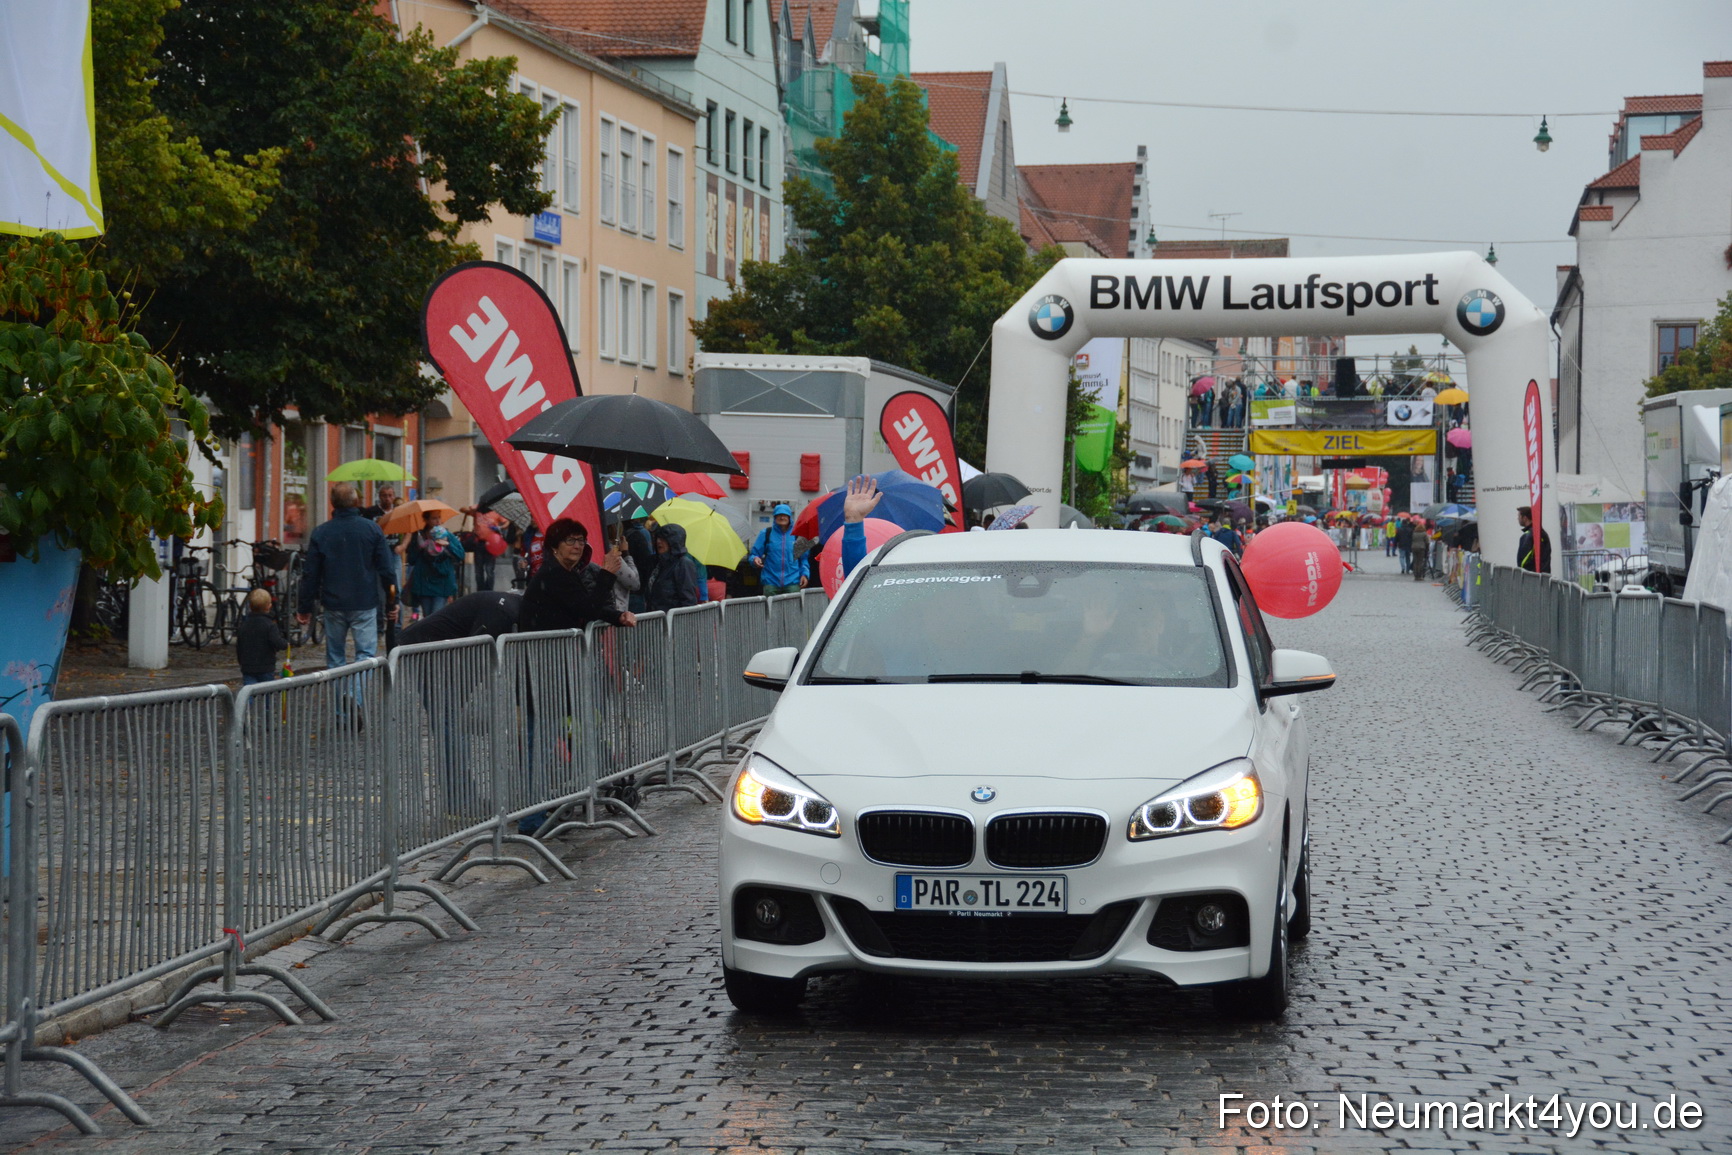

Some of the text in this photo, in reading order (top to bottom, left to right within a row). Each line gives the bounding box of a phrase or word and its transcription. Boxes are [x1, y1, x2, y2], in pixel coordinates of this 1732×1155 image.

[1089, 273, 1440, 317] BMW Laufsport
[1323, 435, 1365, 450] ZIEL
[901, 895, 907, 903] D
[914, 879, 1061, 907] PAR TL 224
